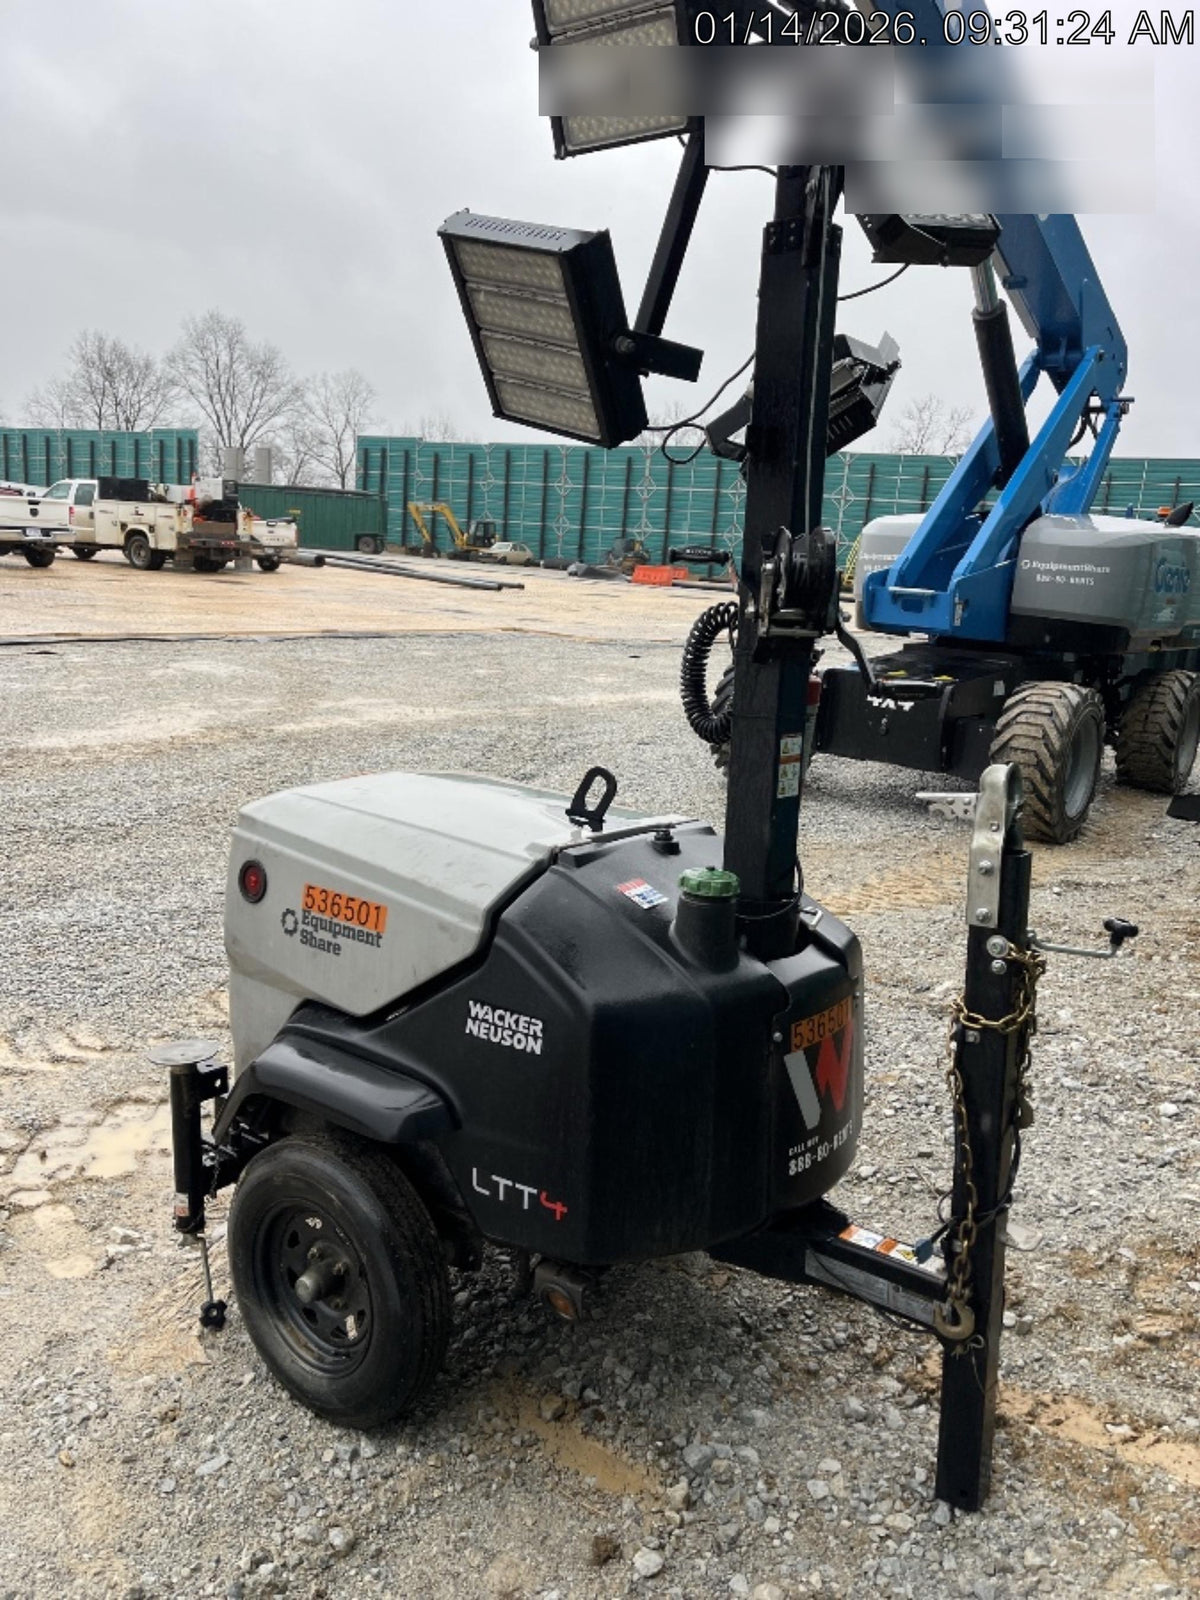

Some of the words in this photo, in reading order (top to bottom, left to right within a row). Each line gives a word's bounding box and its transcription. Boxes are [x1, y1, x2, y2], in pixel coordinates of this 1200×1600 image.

[304, 885, 382, 930] 536501
[300, 929, 342, 956] Share
[301, 910, 383, 948] Equipment
[465, 1018, 543, 1056] NEUSON
[468, 1000, 543, 1038] WACKER
[793, 999, 850, 1050] 536501
